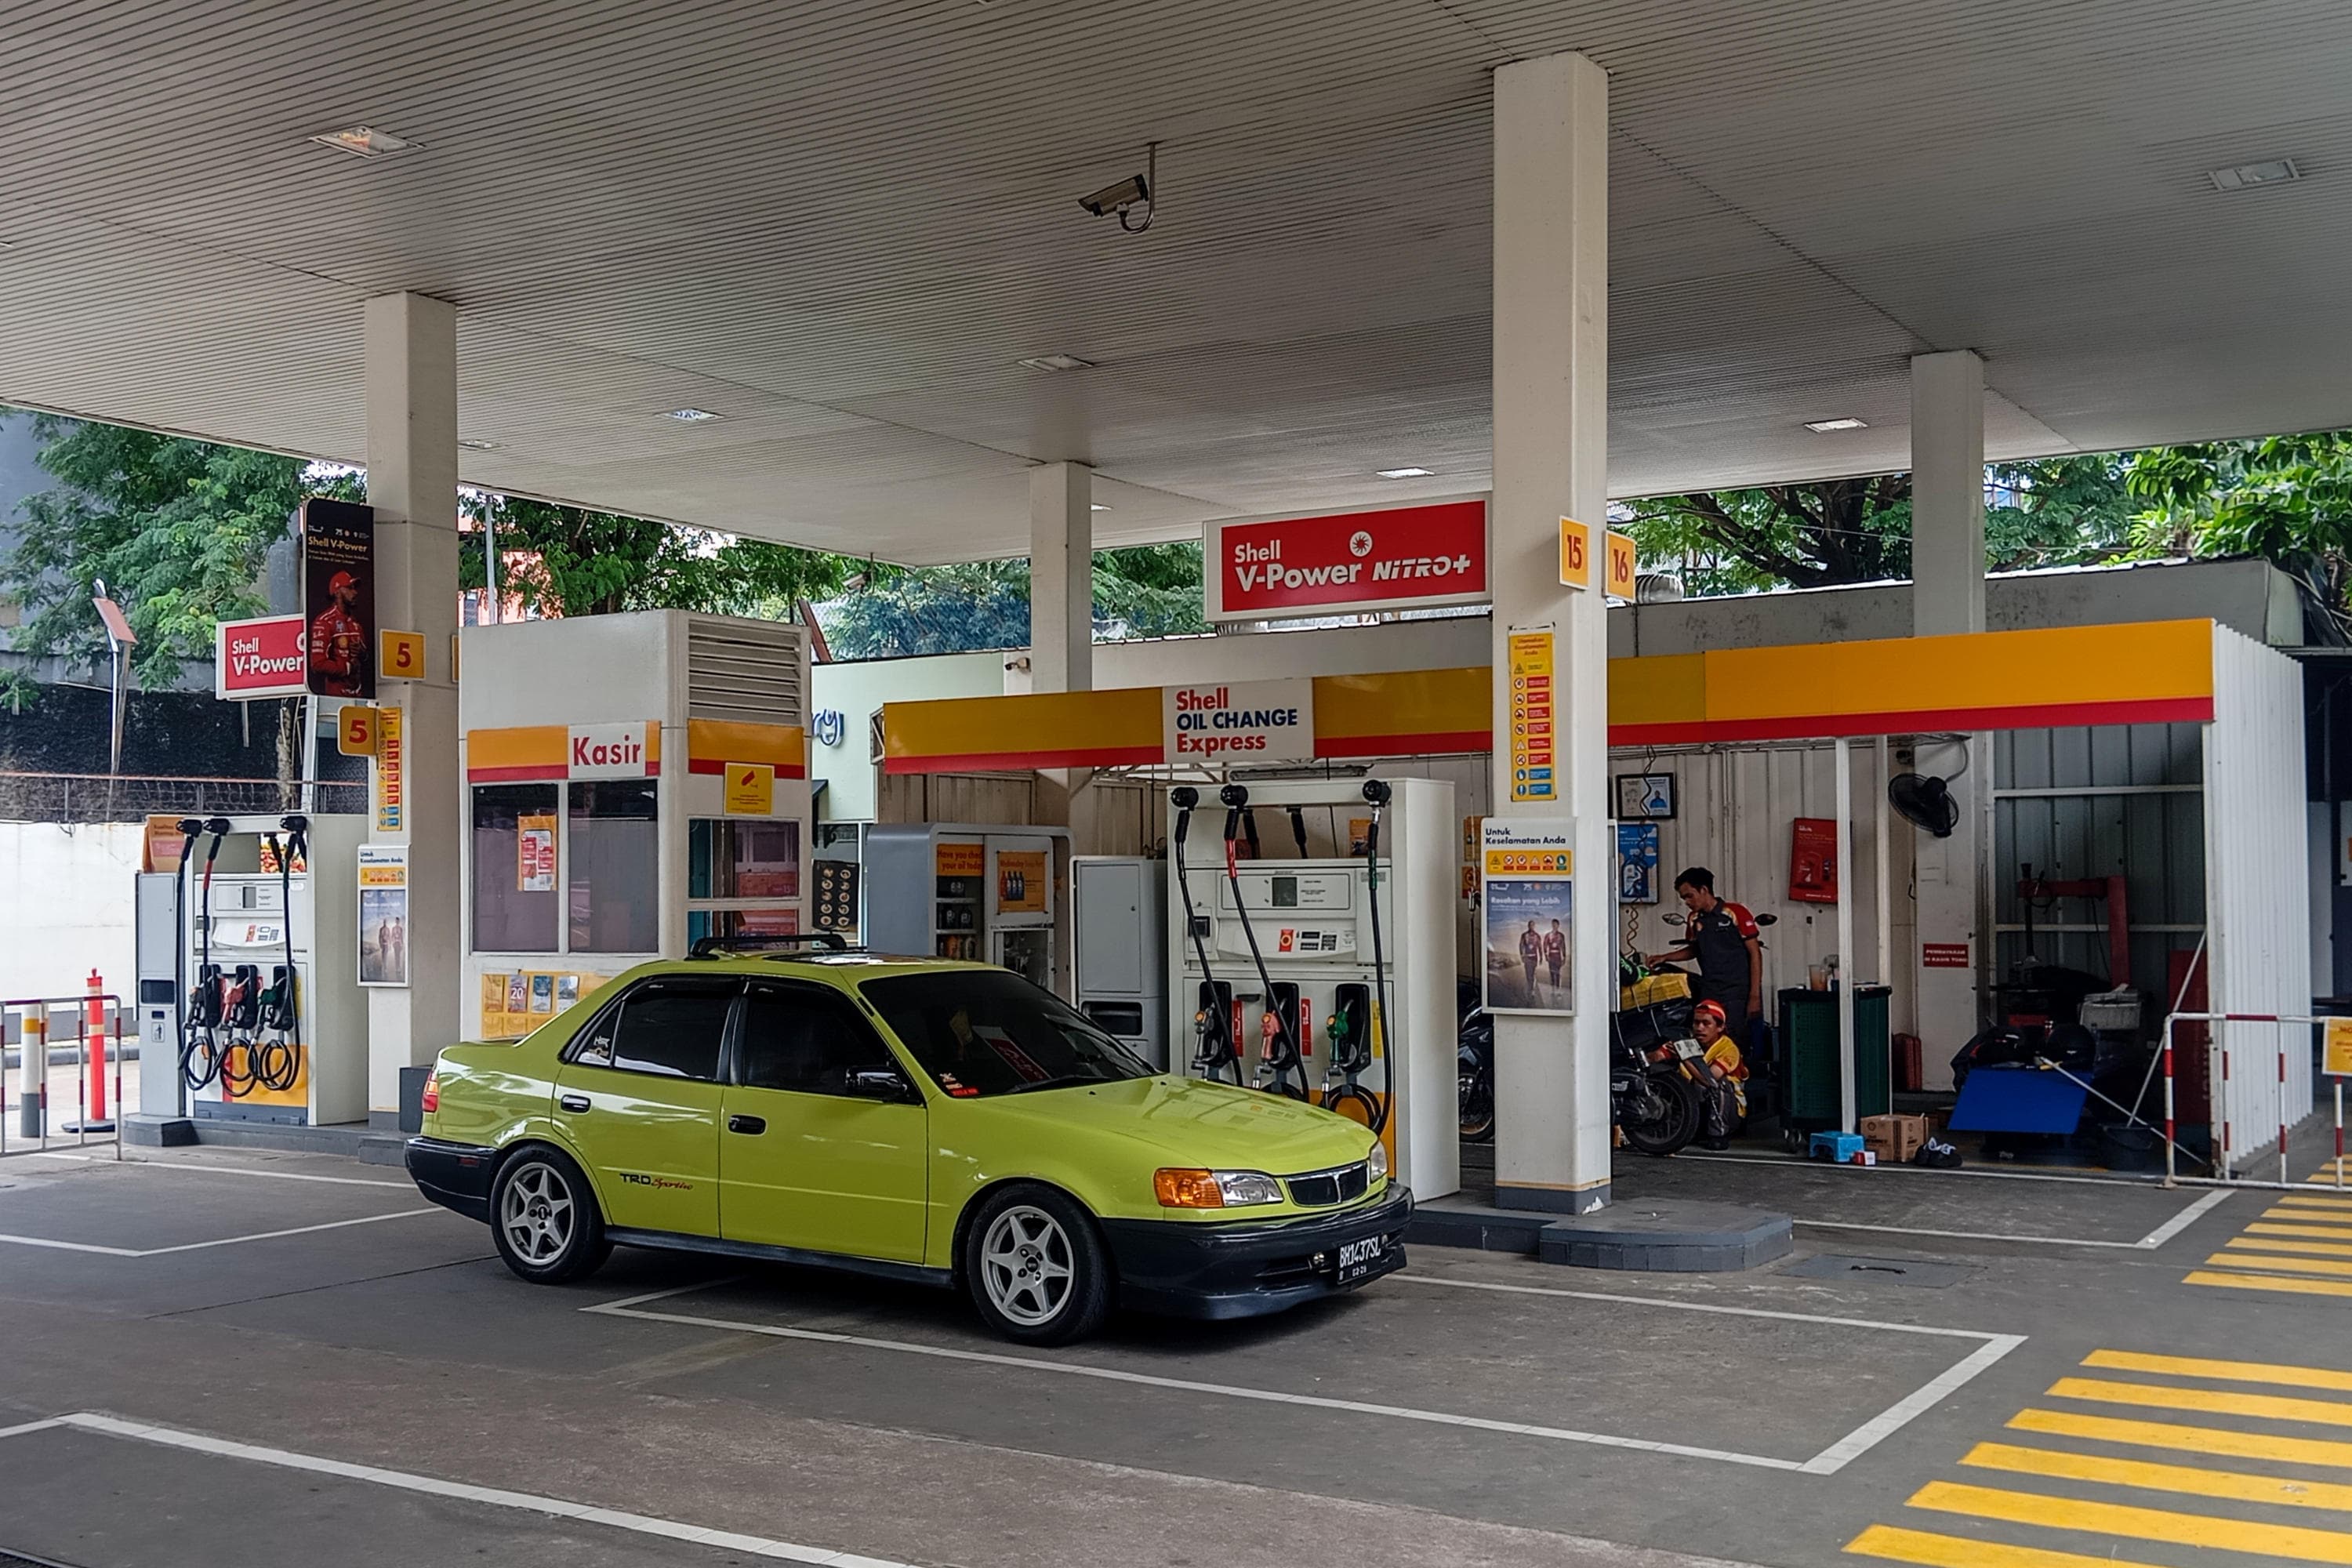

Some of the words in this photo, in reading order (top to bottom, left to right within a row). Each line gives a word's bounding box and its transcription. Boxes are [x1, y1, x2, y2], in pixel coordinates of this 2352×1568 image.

[308, 535, 329, 547] Shell
[330, 539, 368, 552] V-Power
[1234, 539, 1281, 563] Shell
[1566, 533, 1583, 570] 15
[1235, 562, 1363, 592] V-Power
[1613, 547, 1629, 583] 16
[232, 637, 260, 655] Shell
[395, 641, 412, 669] 5
[232, 654, 303, 677] V-Power
[1176, 686, 1229, 711] Shell
[348, 719, 368, 744] 5
[1177, 713, 1208, 731] OIL
[1212, 708, 1298, 730] CHANGE
[573, 734, 641, 767] Kasir
[1177, 732, 1267, 758] Express
[1485, 827, 1512, 836] Untuk
[1485, 837, 1541, 845] Keselamatan
[1542, 835, 1566, 844] Anda
[510, 987, 524, 1000] 20
[619, 1172, 652, 1185] TRD
